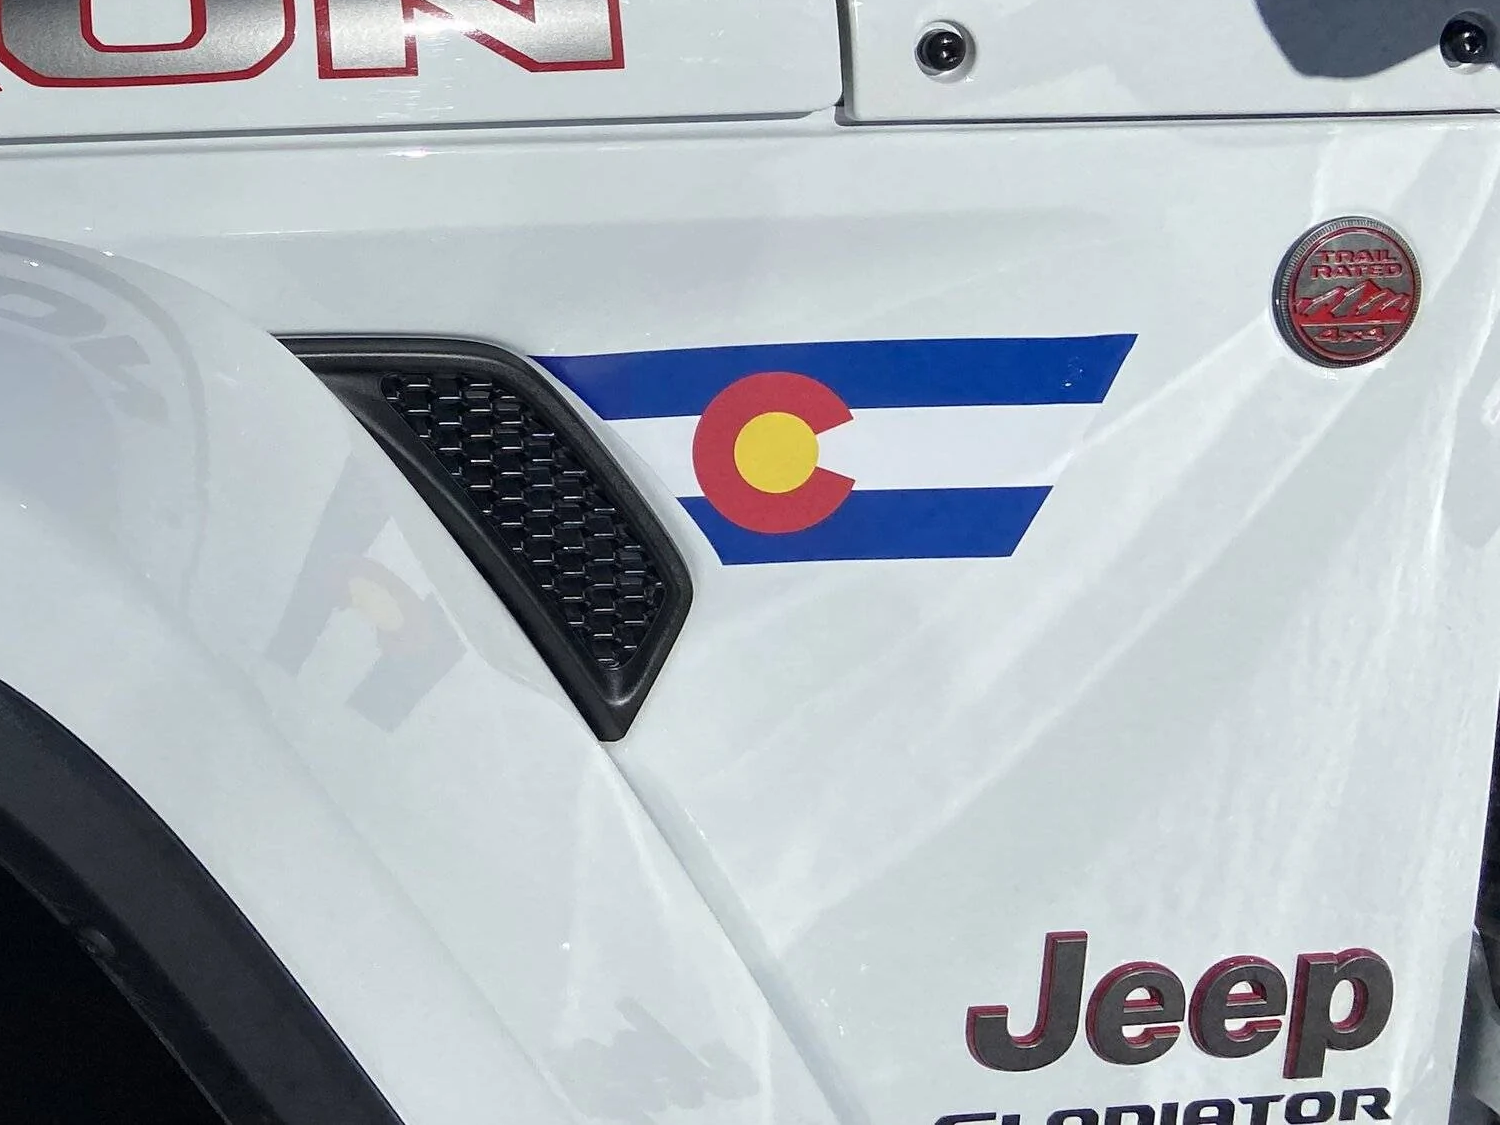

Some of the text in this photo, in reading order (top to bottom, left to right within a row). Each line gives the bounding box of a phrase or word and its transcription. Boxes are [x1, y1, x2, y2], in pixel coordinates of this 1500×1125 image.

[1316, 249, 1396, 263] TRAIL
[1311, 263, 1403, 279] RATED
[967, 930, 1394, 1079] Jeep
